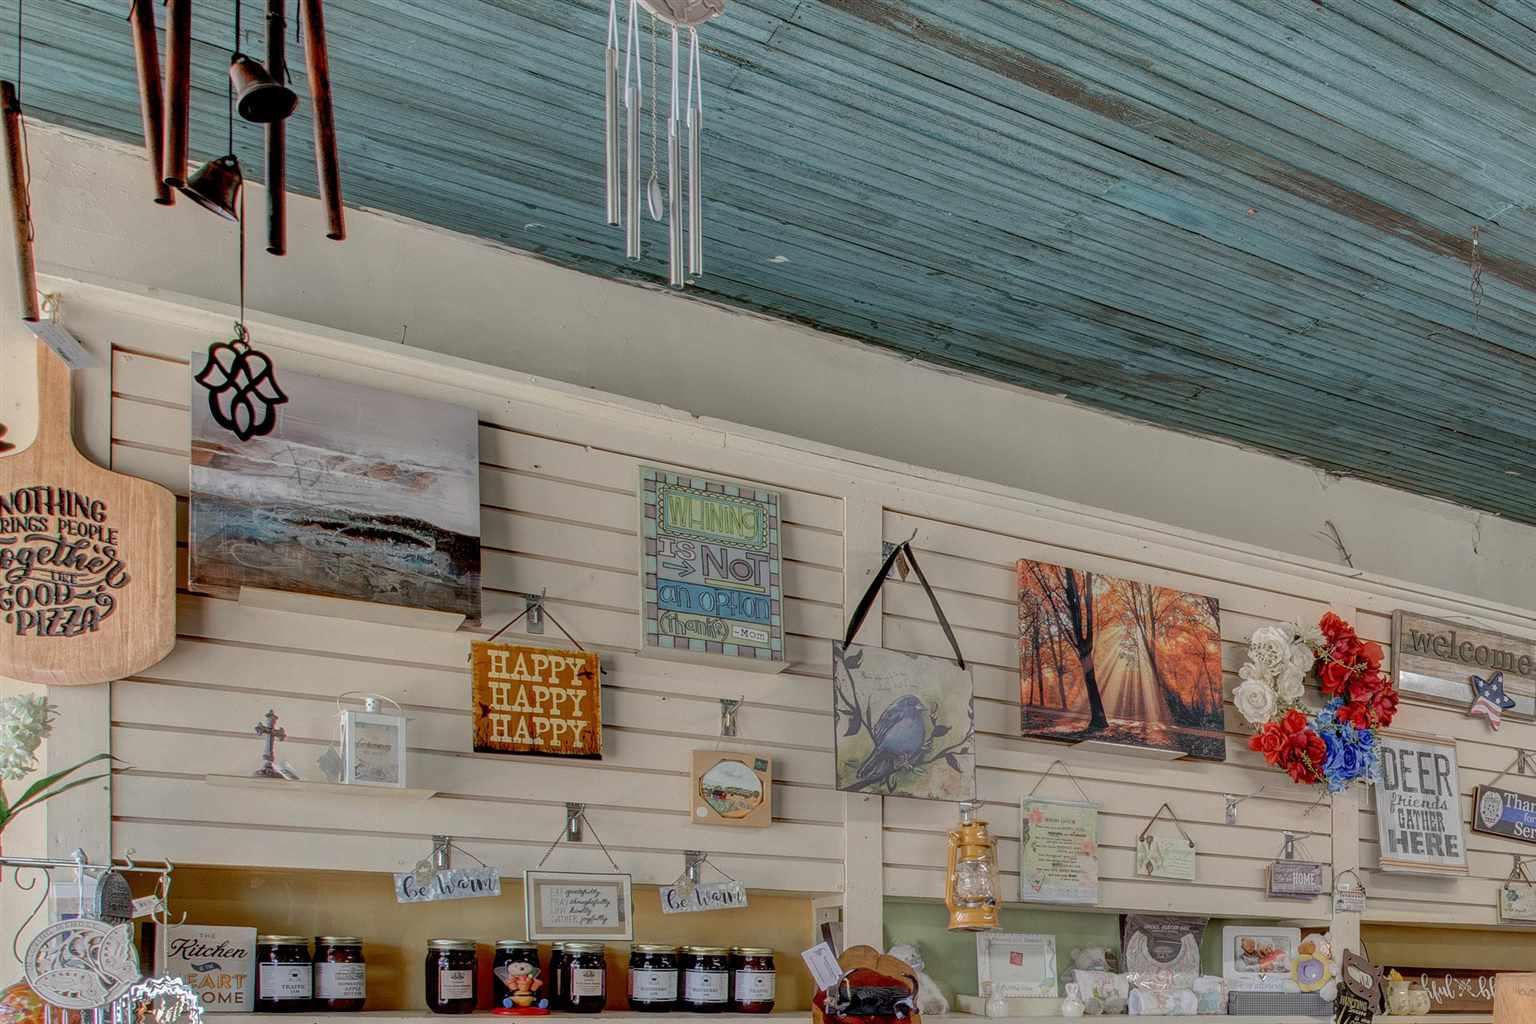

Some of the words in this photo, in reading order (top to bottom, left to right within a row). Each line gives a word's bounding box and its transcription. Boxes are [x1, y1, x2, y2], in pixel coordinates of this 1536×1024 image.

[0, 516, 48, 533] RINGS
[58, 518, 118, 545] PEOPLE
[658, 536, 696, 562] IS
[701, 545, 770, 586] NOT
[16, 605, 112, 637] PIZZA
[1408, 628, 1533, 675] welcome
[487, 649, 586, 686] HAPPY
[488, 681, 587, 717] HAPPY
[489, 712, 590, 748] HAPPY
[1381, 746, 1453, 797] DEER
[1398, 807, 1445, 832] GATHER
[1523, 812, 1536, 823] for
[1388, 829, 1459, 857] HERE
[1292, 871, 1315, 886] HOME
[170, 936, 249, 961] Kitchen
[187, 973, 247, 990] EART
[202, 991, 245, 1004] OME
